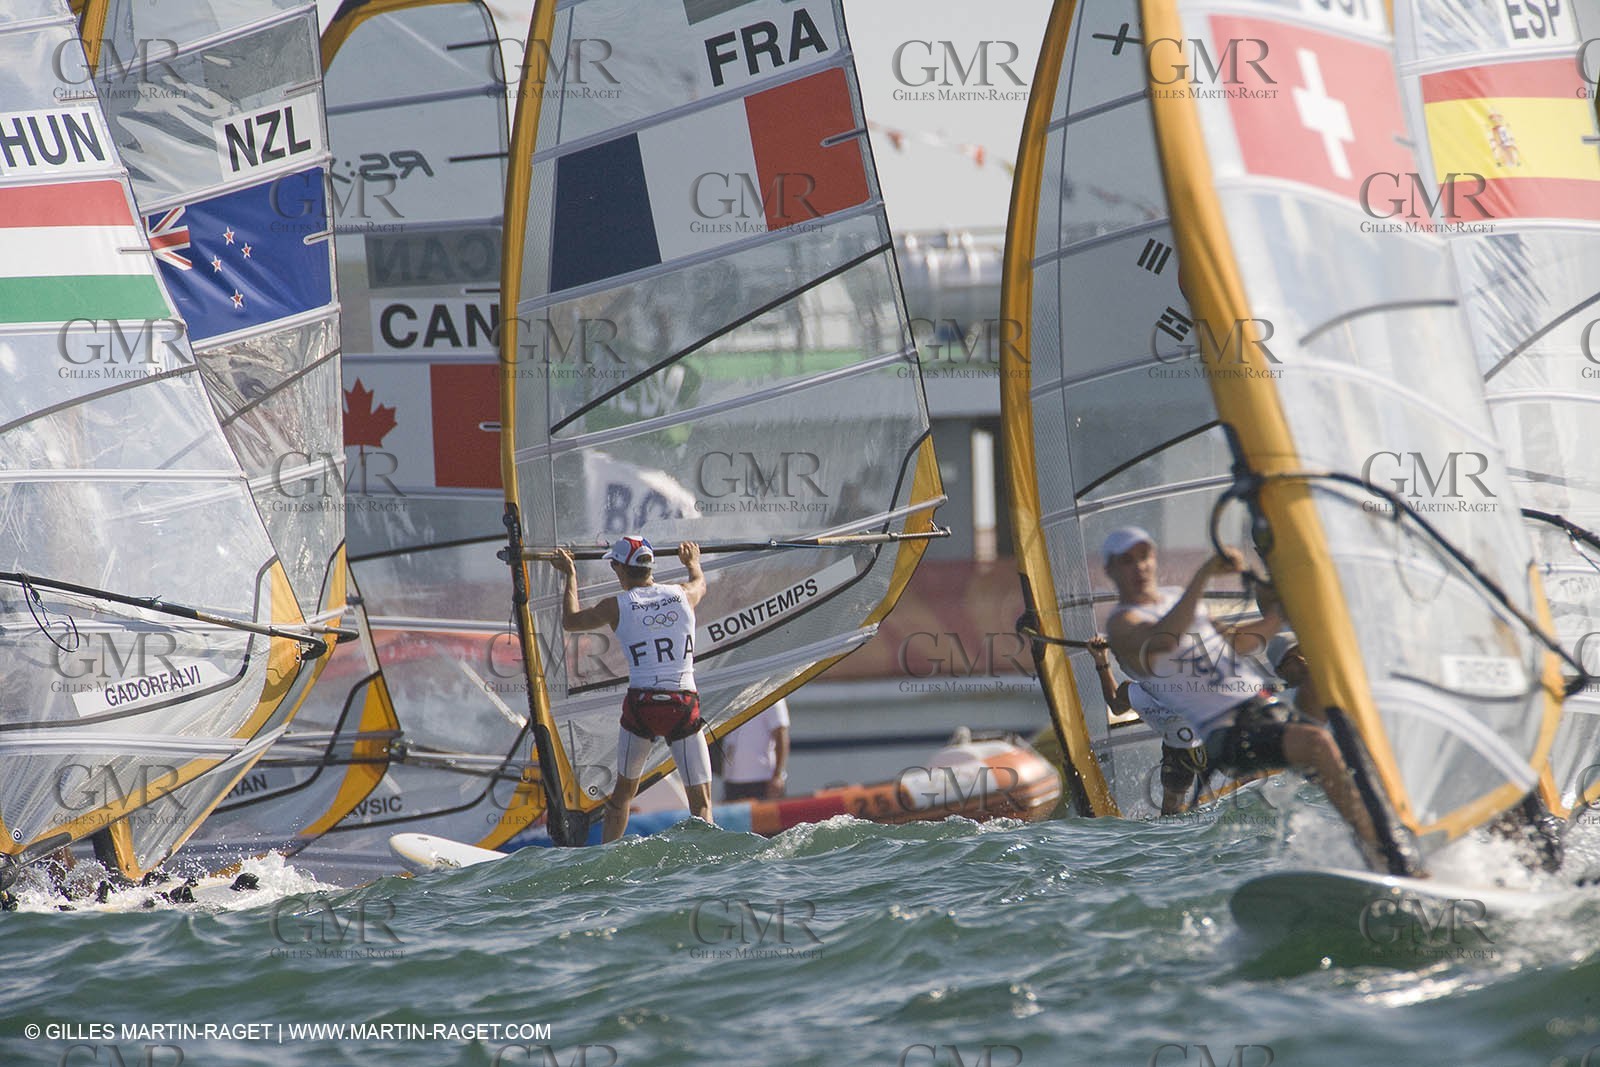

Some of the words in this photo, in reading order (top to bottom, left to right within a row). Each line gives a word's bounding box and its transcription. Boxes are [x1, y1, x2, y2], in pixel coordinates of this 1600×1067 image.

[704, 8, 828, 87] FRA
[0, 112, 105, 168] HUN
[225, 106, 311, 172] NZL
[379, 303, 500, 350] CAN
[707, 578, 818, 643] BONTEMPS
[628, 633, 694, 667] FRA
[104, 665, 201, 707] GADORFALVI
